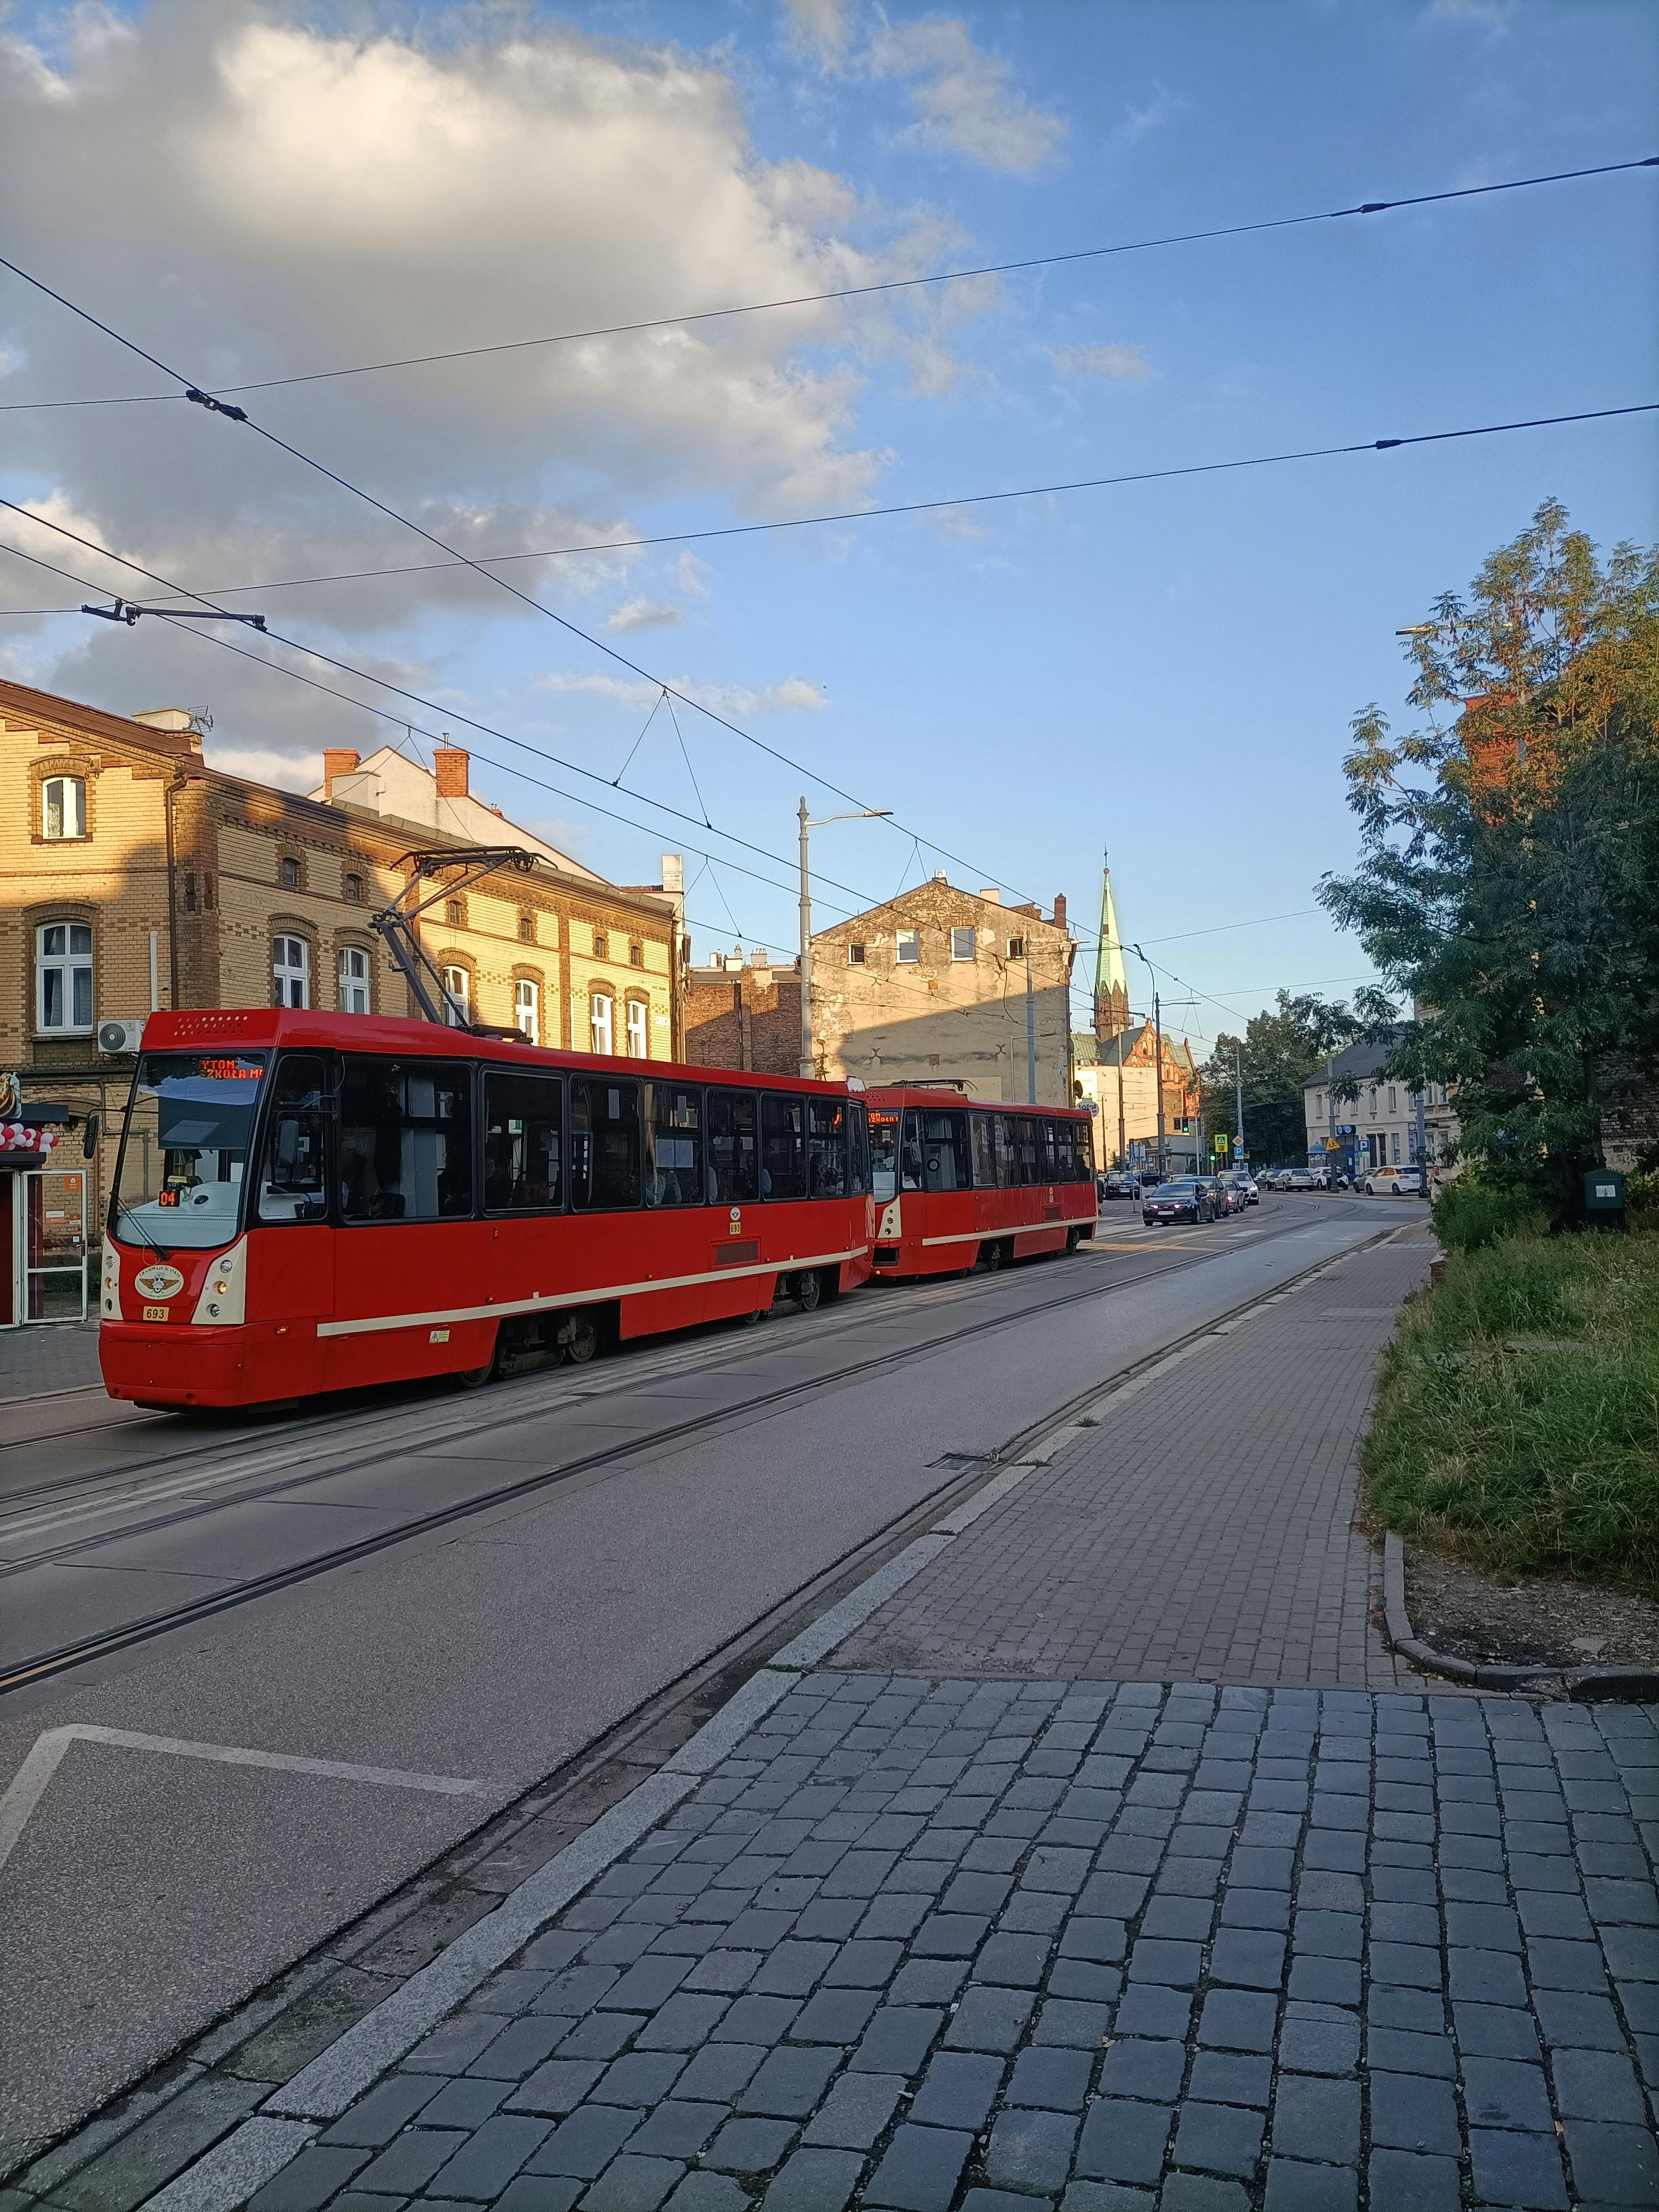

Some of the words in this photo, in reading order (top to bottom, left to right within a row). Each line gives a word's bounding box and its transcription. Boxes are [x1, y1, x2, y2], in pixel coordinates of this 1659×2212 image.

[1360, 1141, 1367, 1151] P
[161, 1192, 175, 1206] 04
[731, 1224, 740, 1233] 693
[147, 1308, 164, 1319] 693
